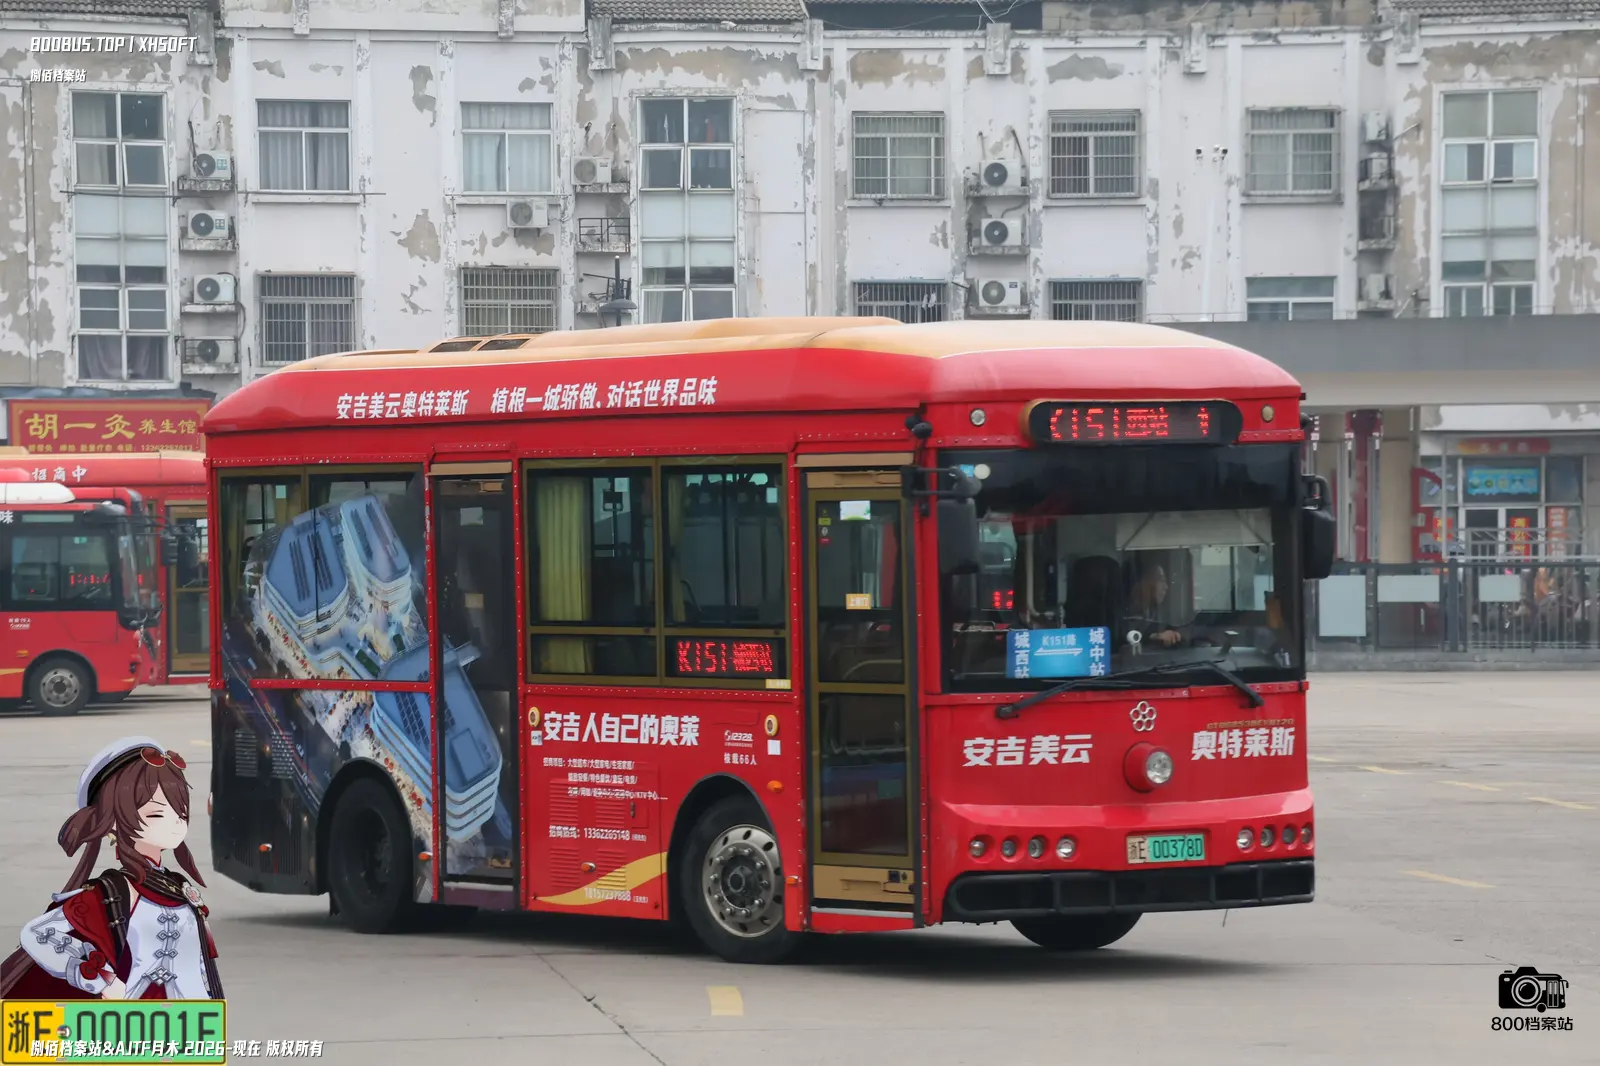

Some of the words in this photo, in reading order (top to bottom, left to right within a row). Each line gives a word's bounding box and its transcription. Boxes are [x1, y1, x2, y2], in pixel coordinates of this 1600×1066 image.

[336, 389, 470, 420] 安吉美云奥特莱斯
[25, 413, 136, 440] 胡一灸
[138, 420, 197, 434] 养生馆
[32, 466, 88, 482] 招商中
[1089, 628, 1106, 676] 城中站
[543, 711, 701, 747] 安吉人自己的奥莱
[962, 734, 1094, 767] 安吉美云
[1191, 727, 1295, 761] 奥特莱斯
[1152, 838, 1204, 859] 00378D
